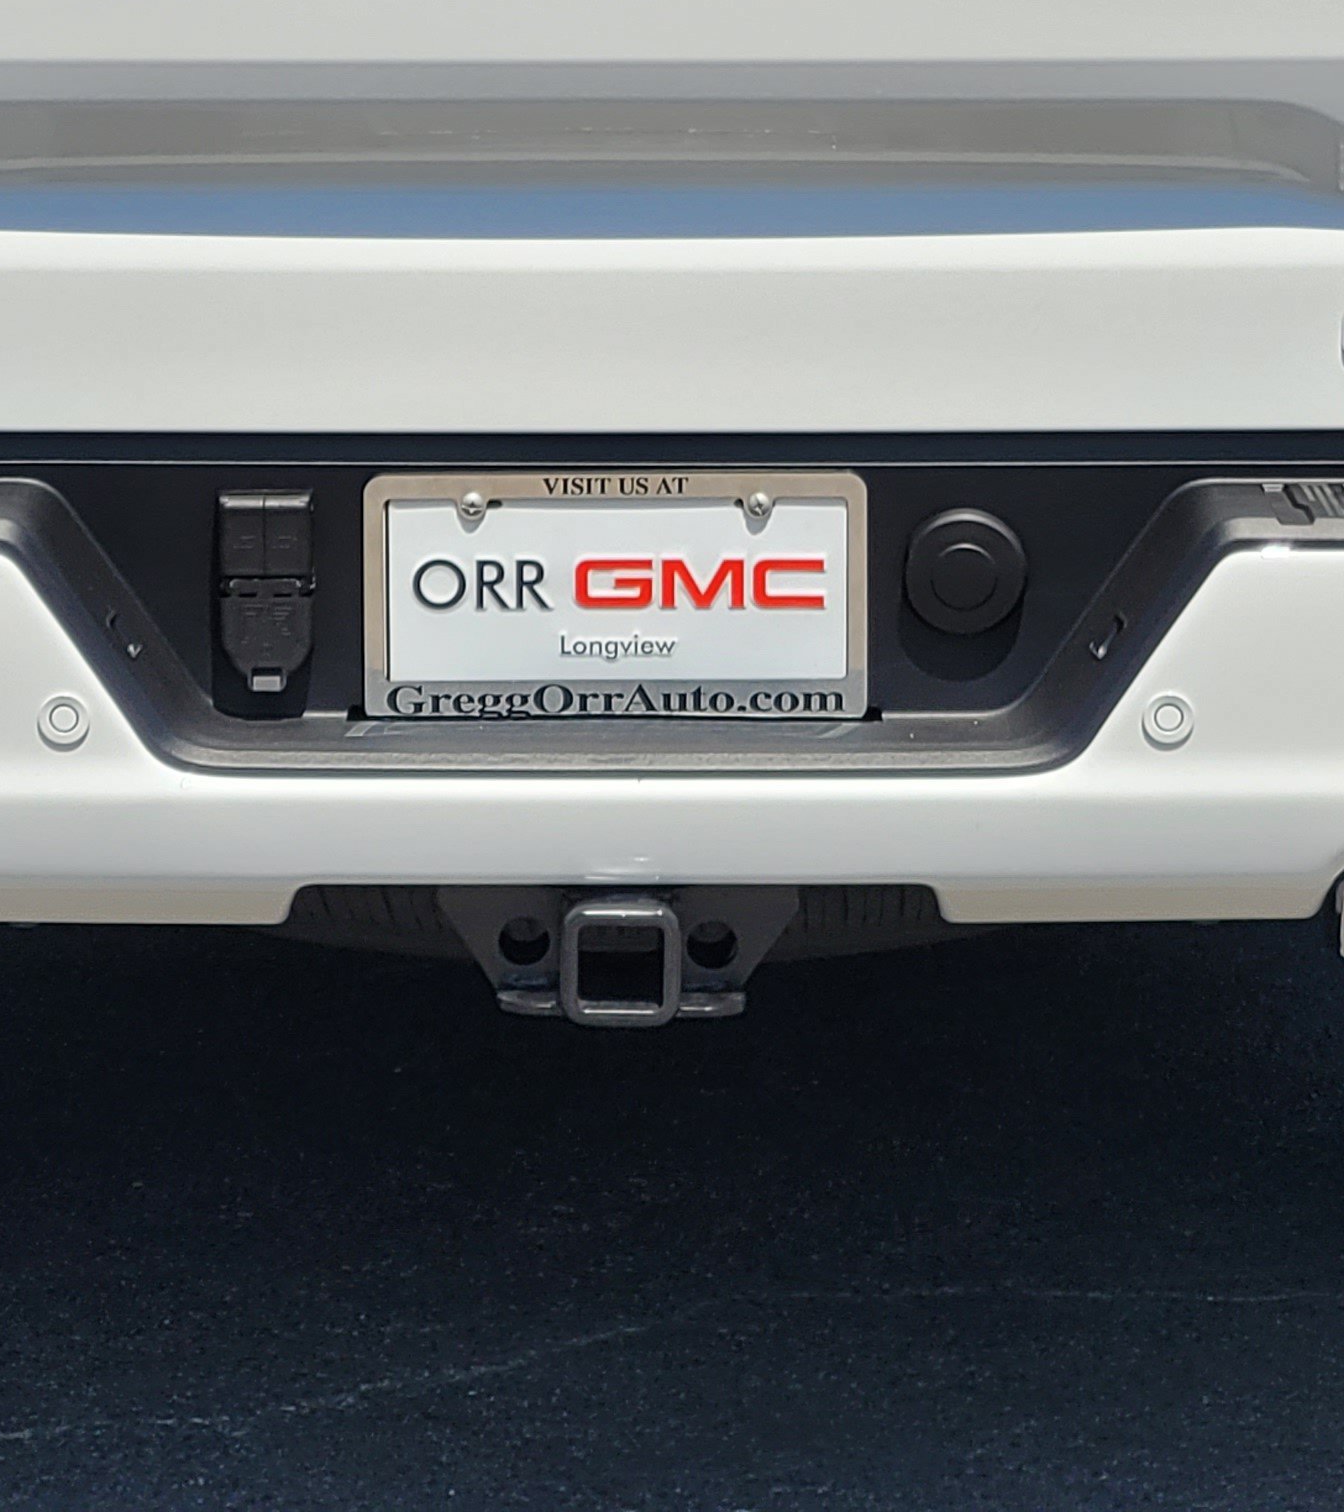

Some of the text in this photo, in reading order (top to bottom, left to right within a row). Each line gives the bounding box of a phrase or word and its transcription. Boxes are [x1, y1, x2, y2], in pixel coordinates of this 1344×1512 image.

[542, 477, 690, 496] VISIT US AT
[413, 559, 826, 611] ORR GMC
[560, 634, 676, 660] Longview
[386, 683, 845, 717] GreggOrrAuto.com
